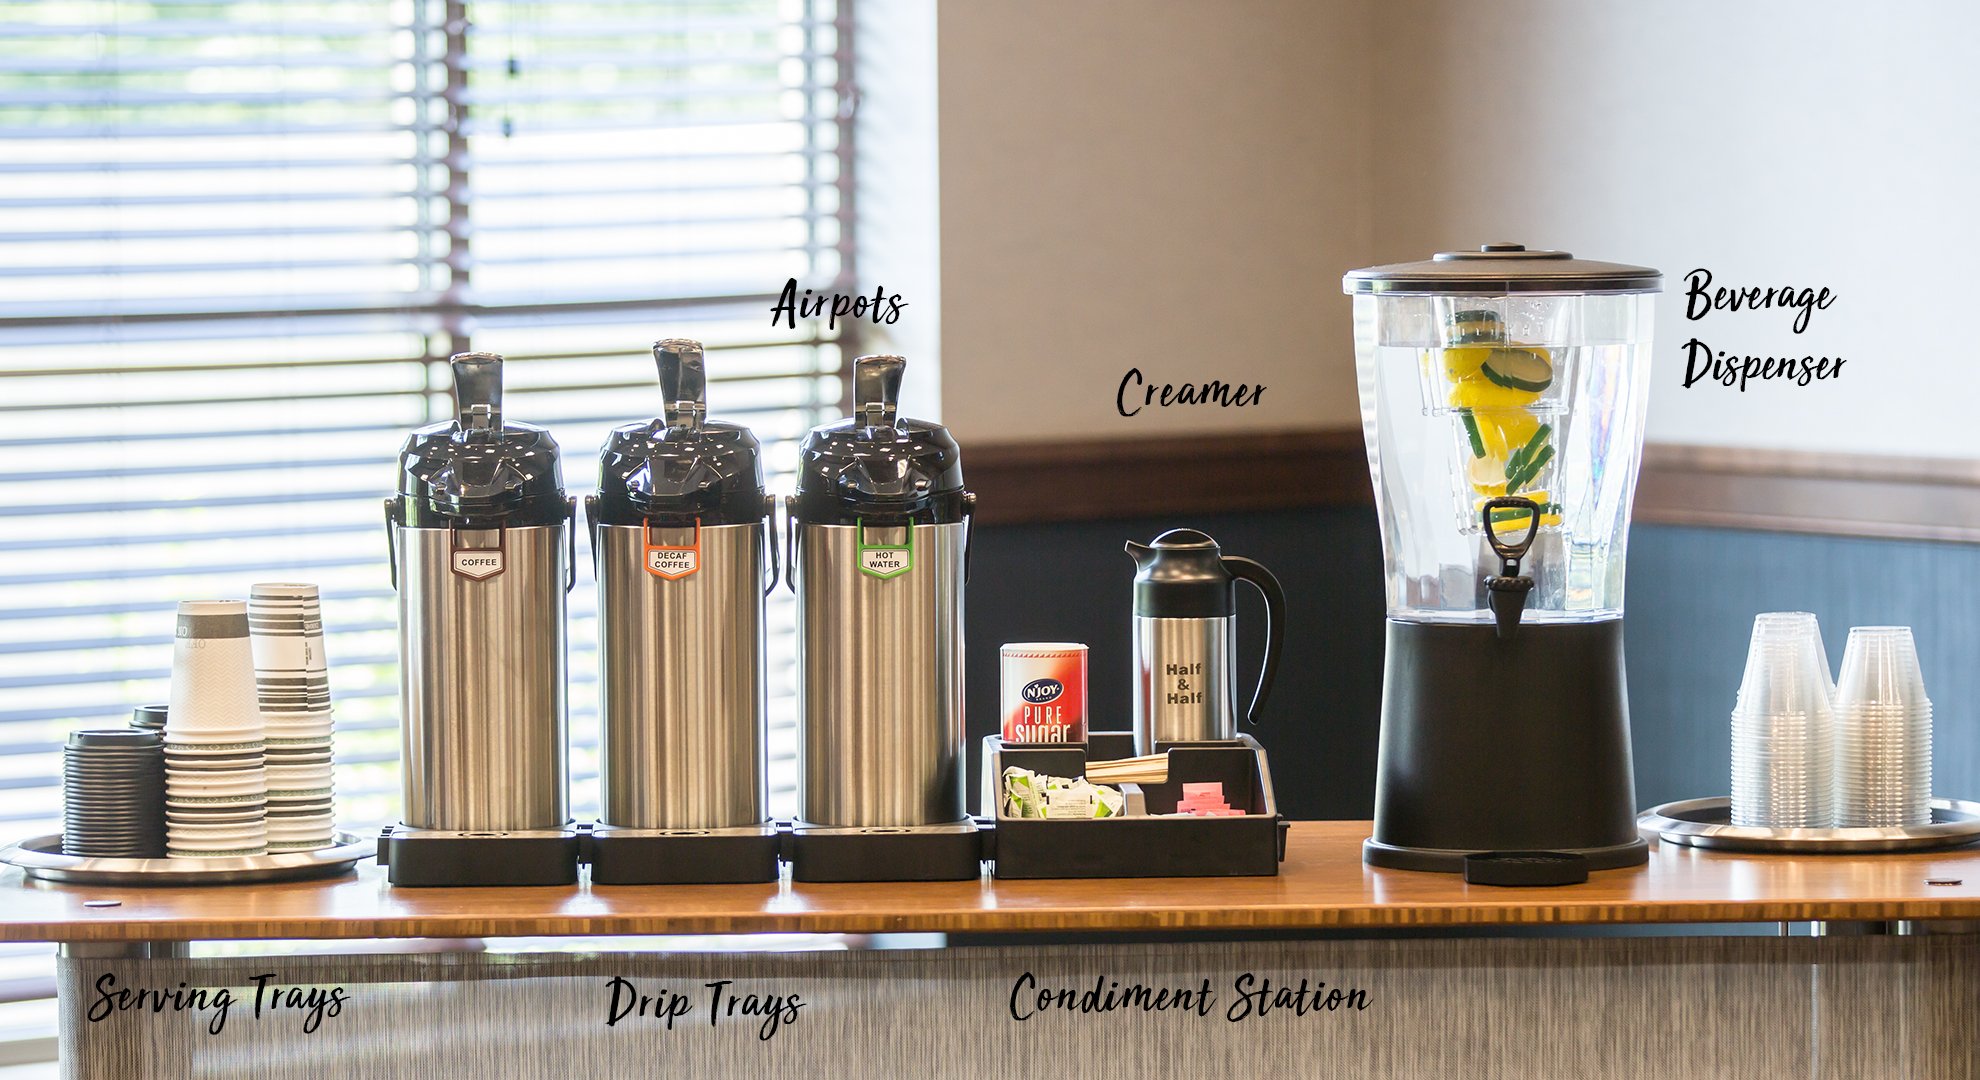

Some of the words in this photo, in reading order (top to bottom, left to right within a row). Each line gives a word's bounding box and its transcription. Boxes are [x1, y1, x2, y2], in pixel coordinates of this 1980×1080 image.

[875, 551, 894, 559] HOT
[461, 558, 497, 566] COFFEE
[869, 560, 900, 568] WATER
[1166, 663, 1202, 675] Half
[1177, 678, 1190, 691] &
[1167, 692, 1203, 704] Half
[1024, 705, 1063, 724] PURE
